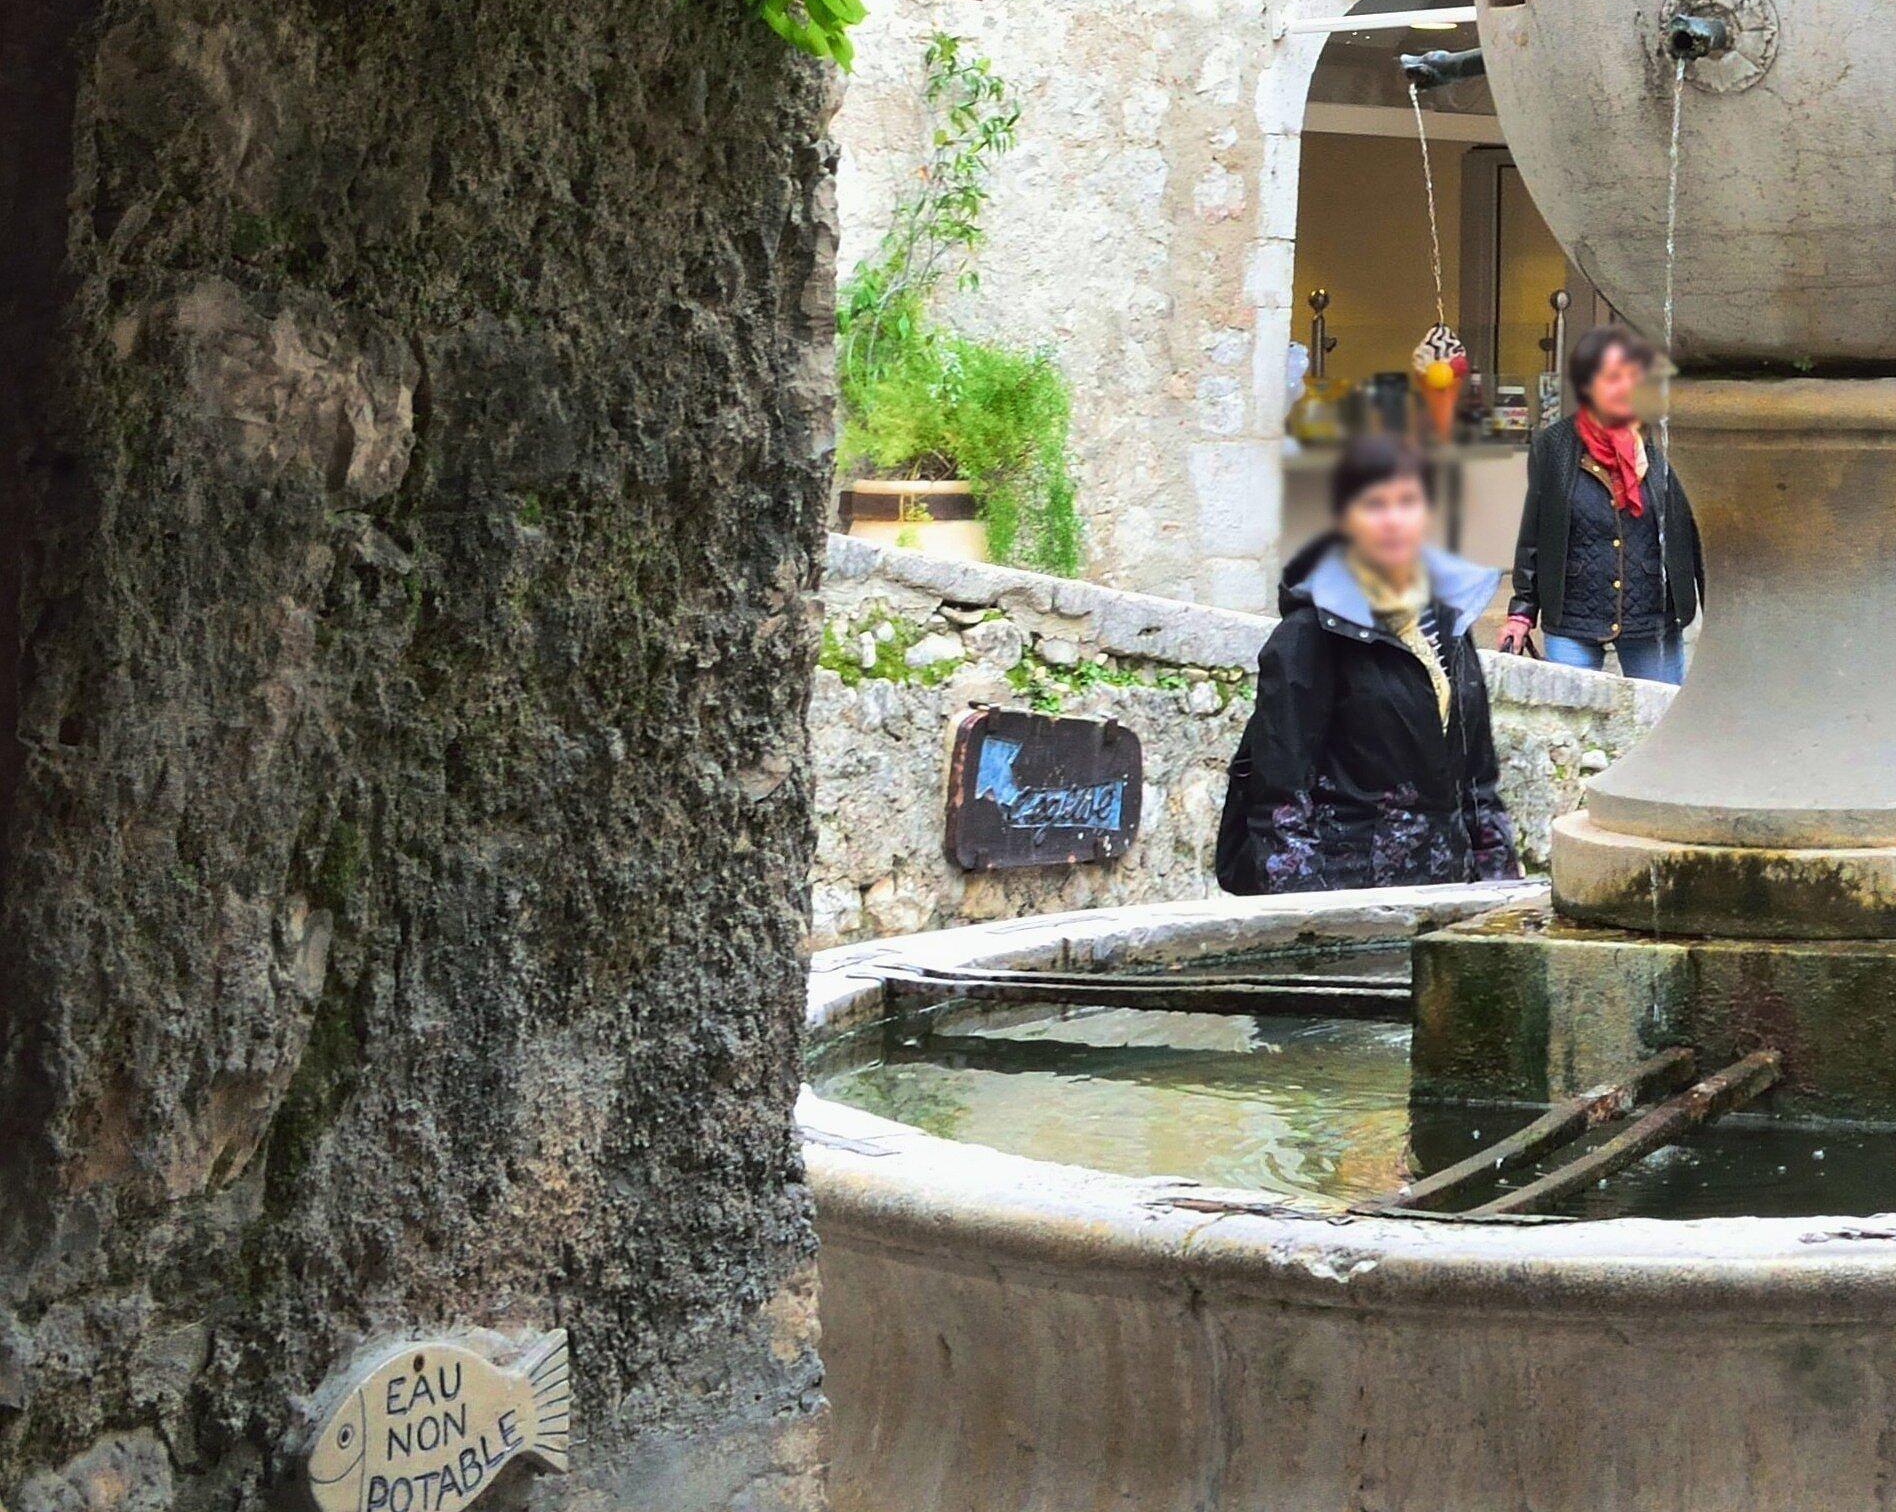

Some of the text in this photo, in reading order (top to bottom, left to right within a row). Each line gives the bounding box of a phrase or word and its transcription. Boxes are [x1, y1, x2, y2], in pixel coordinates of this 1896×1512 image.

[386, 1361, 462, 1415] EAU
[367, 1409, 523, 1512] POTABLE
[387, 1403, 466, 1461] NON
